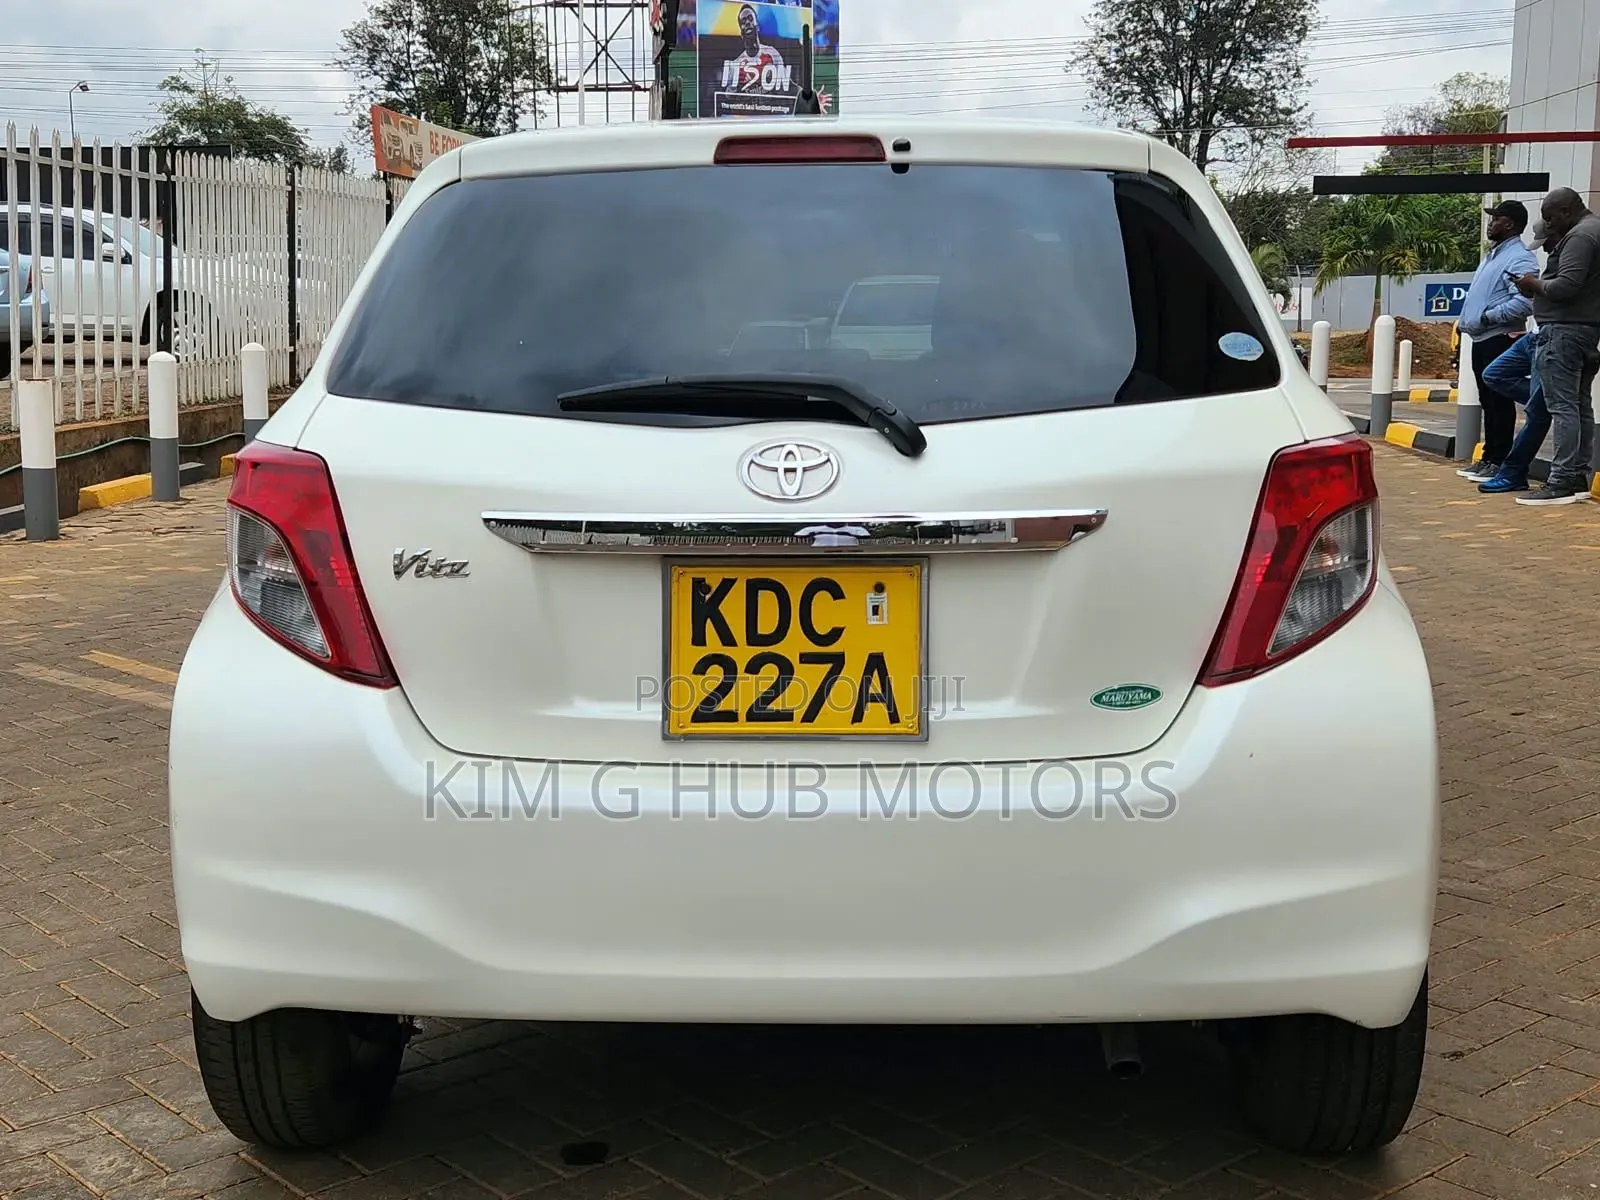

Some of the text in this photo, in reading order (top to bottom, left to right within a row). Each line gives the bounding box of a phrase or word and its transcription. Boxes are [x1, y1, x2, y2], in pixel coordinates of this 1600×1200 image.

[761, 65, 791, 91] ON
[429, 130, 440, 156] BE
[393, 547, 470, 581] Vitz
[690, 577, 847, 648] KDC
[690, 650, 901, 725] 227A
